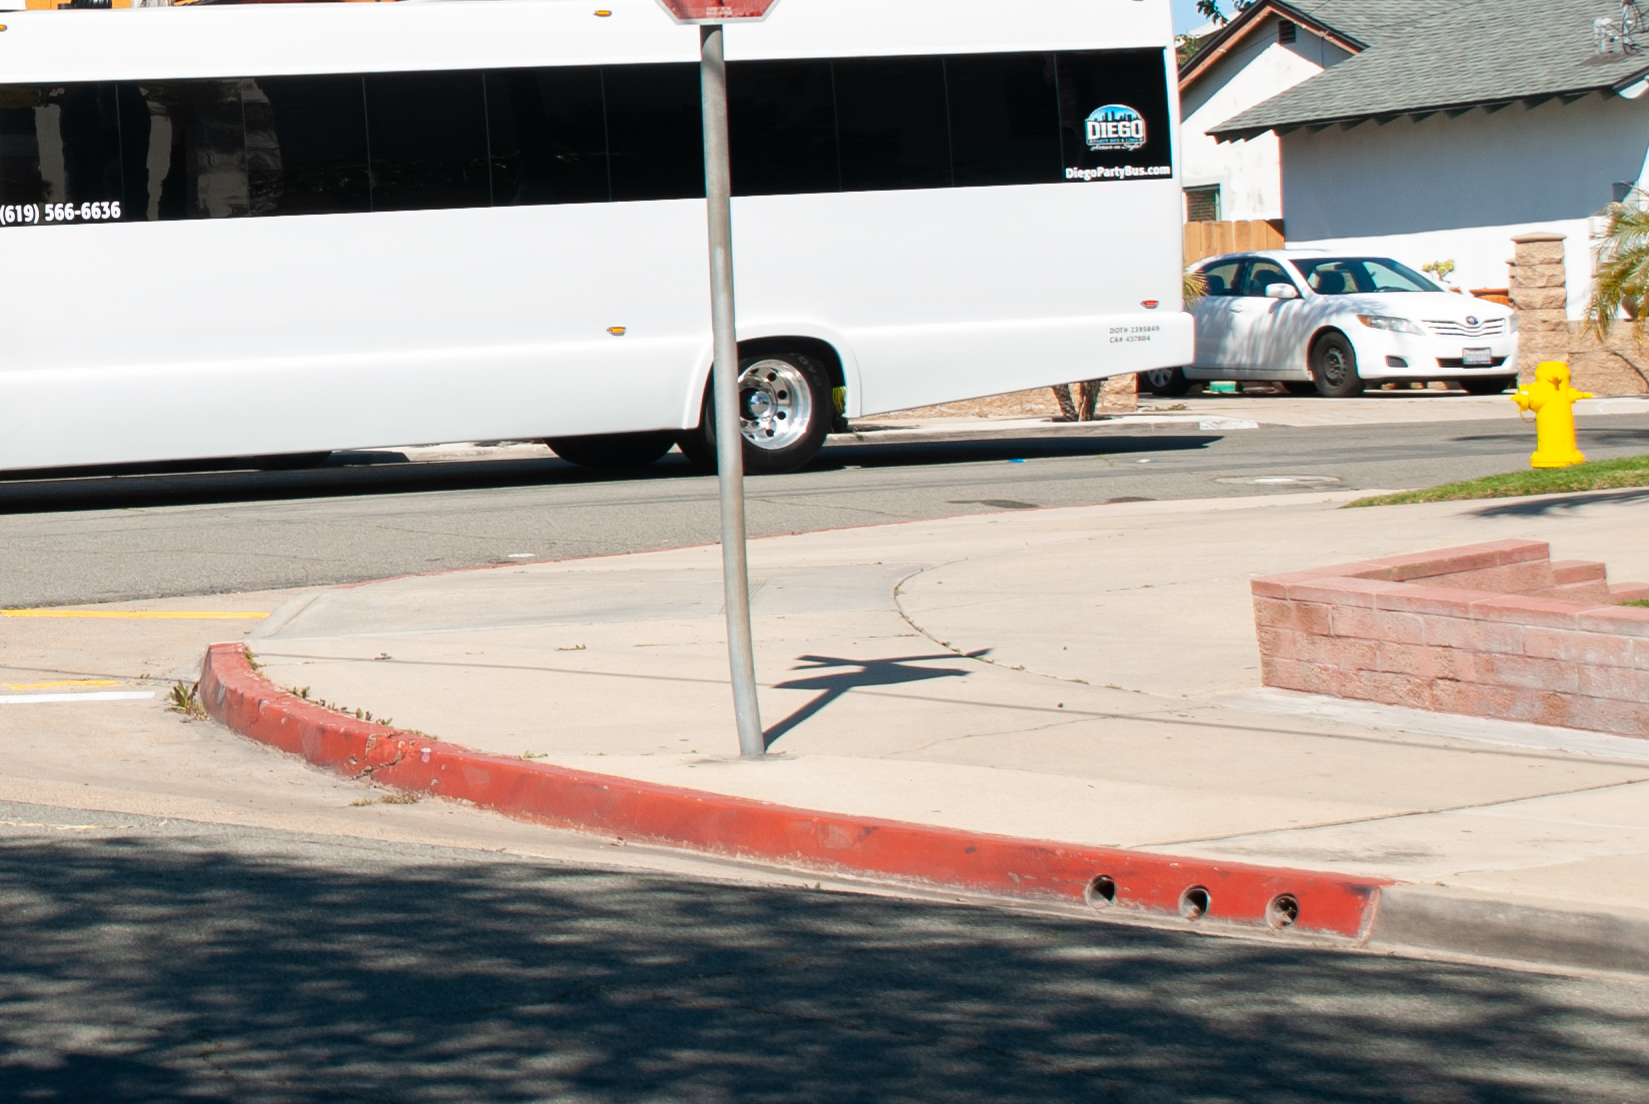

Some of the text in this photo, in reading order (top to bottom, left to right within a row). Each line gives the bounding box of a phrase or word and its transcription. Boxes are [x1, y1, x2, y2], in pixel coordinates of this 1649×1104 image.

[1086, 119, 1144, 140] DIEGO
[1065, 164, 1171, 181] DiegoPartyBus.com
[0, 201, 121, 225] (619) 566-6636
